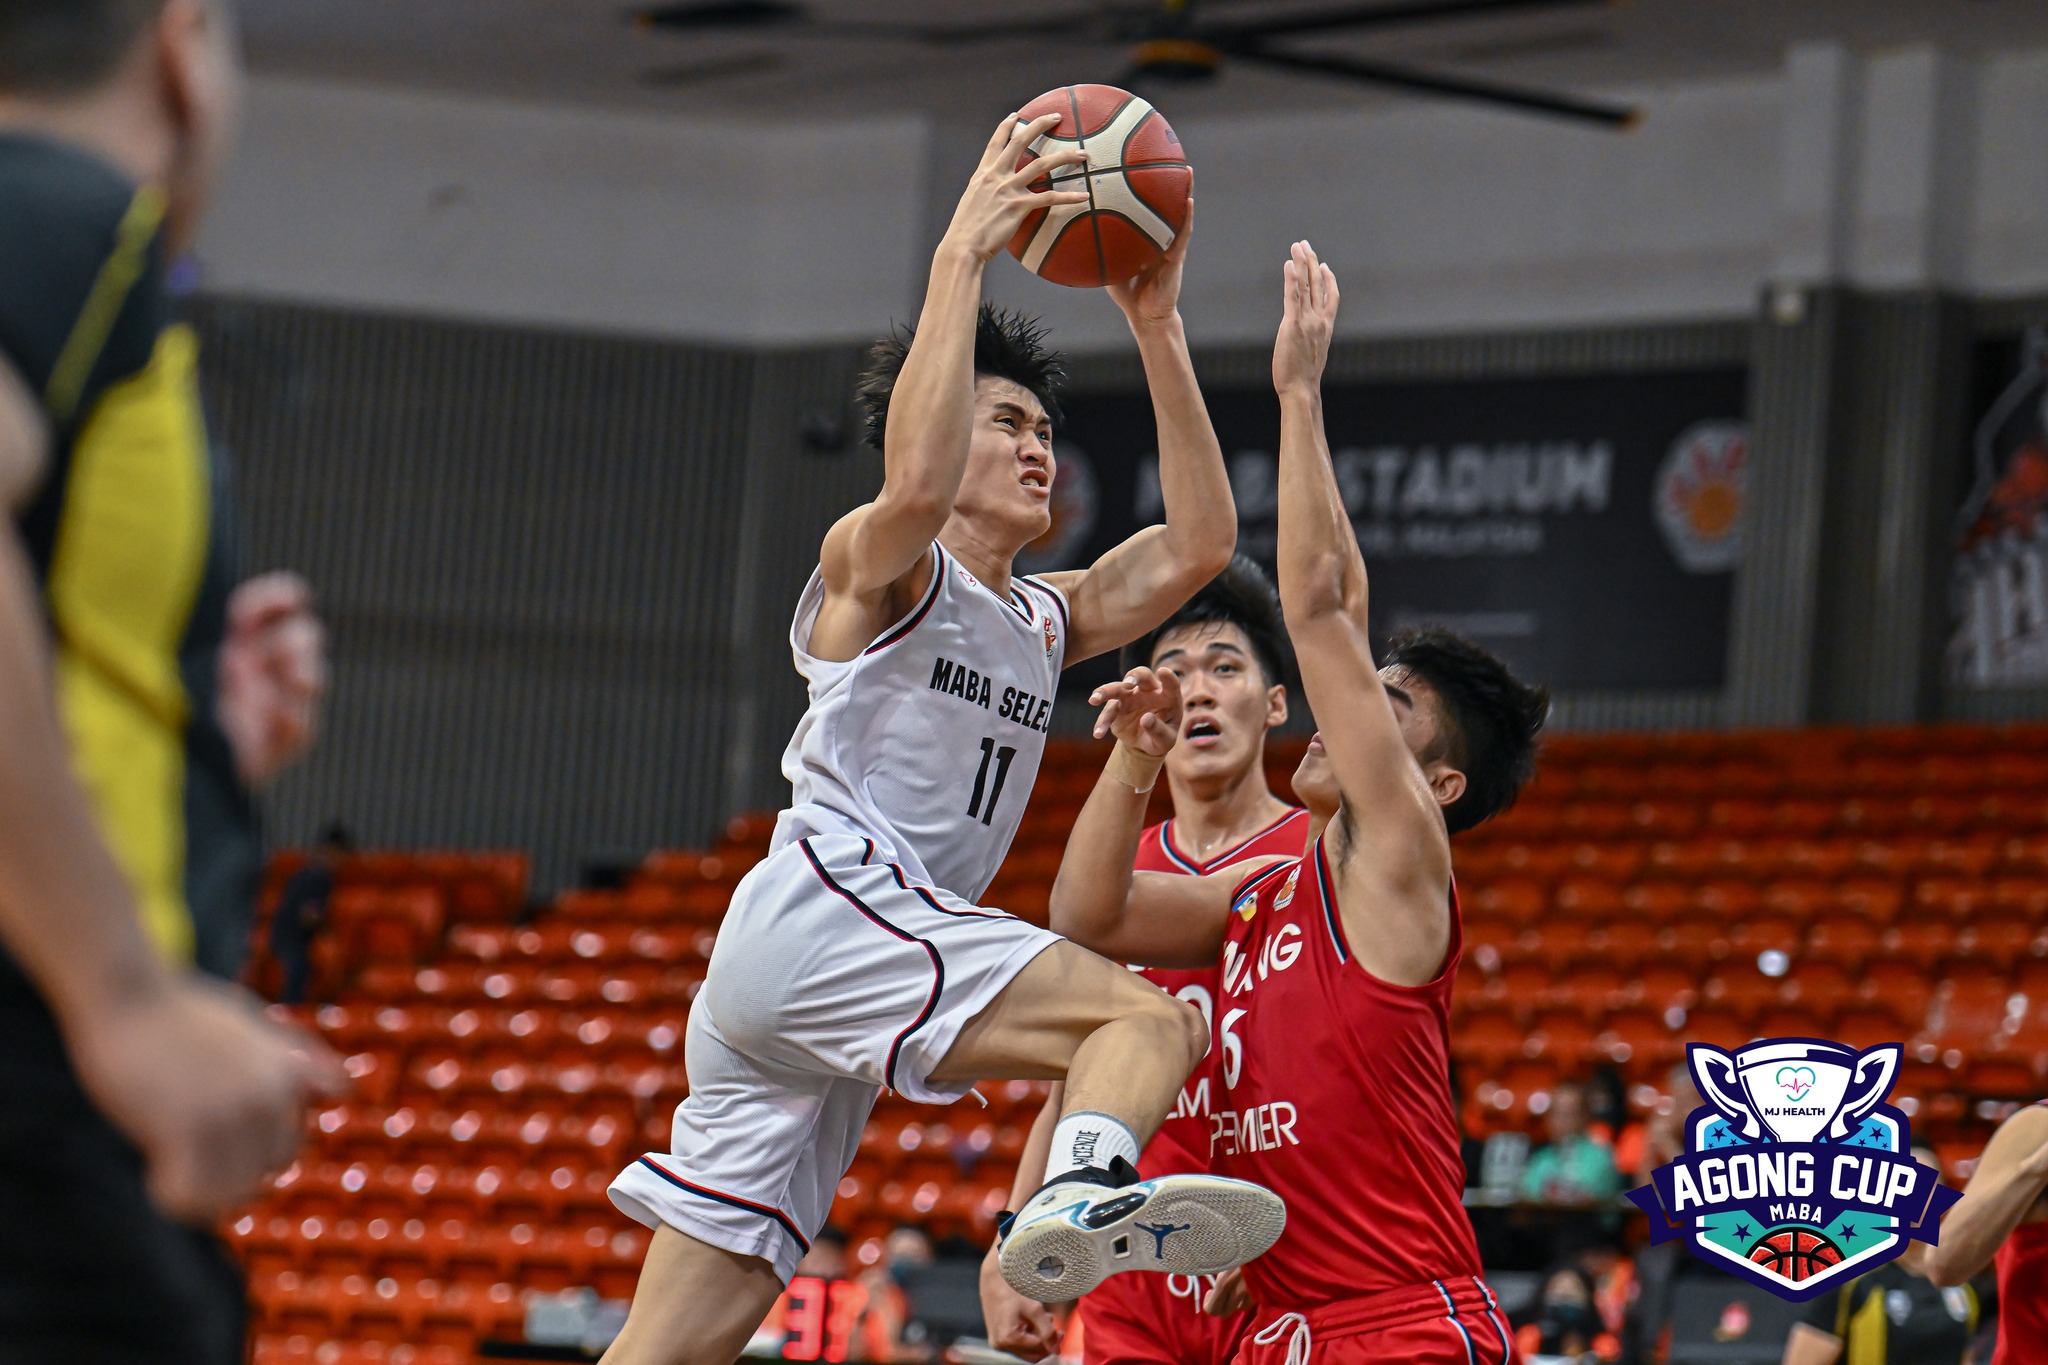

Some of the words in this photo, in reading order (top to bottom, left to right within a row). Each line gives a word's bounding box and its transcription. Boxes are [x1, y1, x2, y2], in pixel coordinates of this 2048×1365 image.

[1333, 438, 1613, 515] STADIUM
[930, 657, 991, 709] MABA
[967, 737, 1018, 826] 11
[1220, 1008, 1248, 1090] 6
